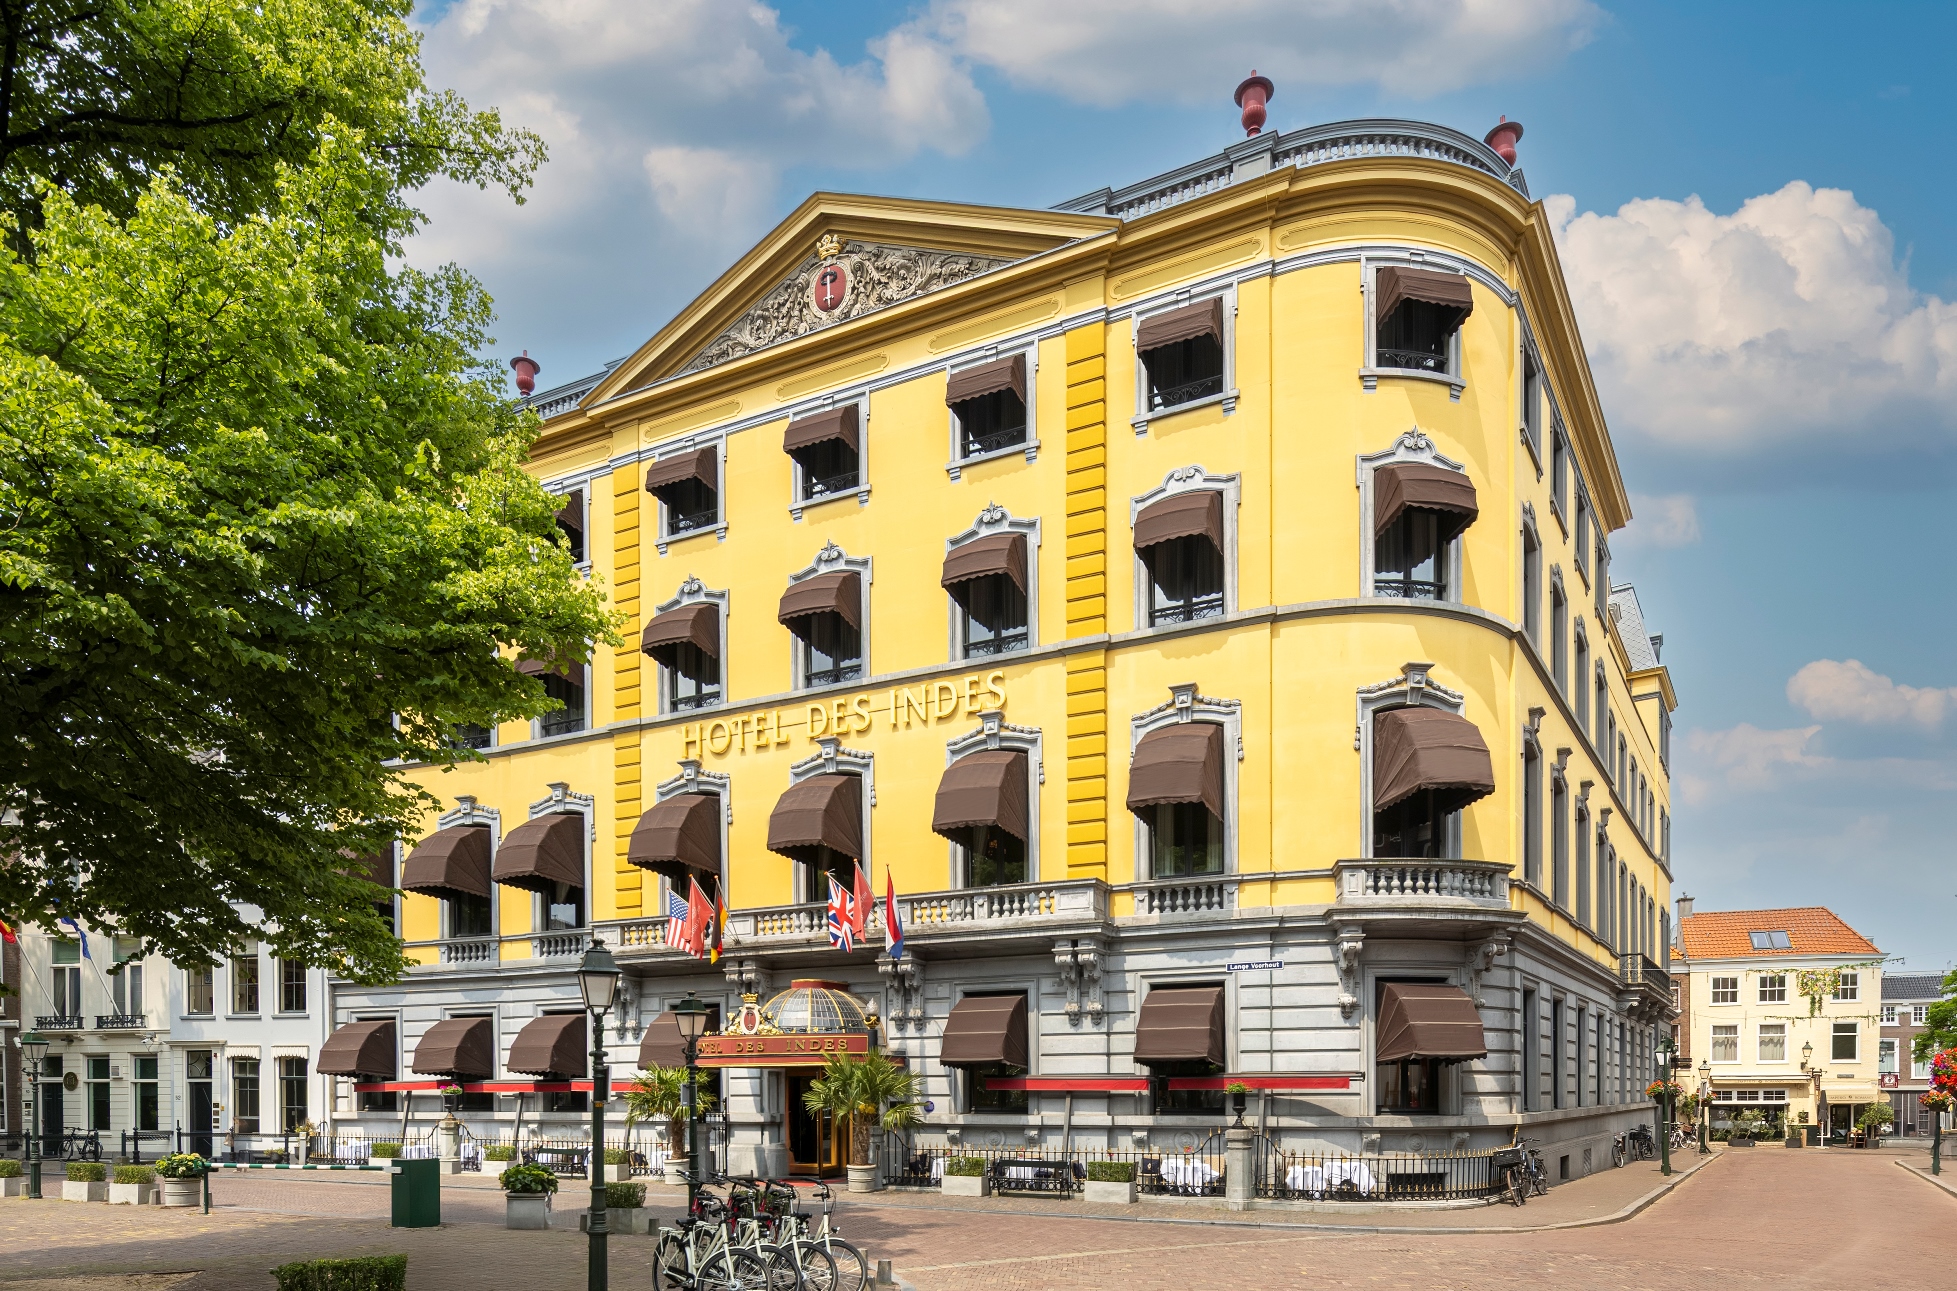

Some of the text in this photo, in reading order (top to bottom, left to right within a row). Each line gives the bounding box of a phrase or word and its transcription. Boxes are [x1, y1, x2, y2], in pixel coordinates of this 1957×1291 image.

[681, 671, 1007, 758] HOTEL DES INDES
[736, 1041, 765, 1052] DES
[786, 1039, 849, 1051] INDES
